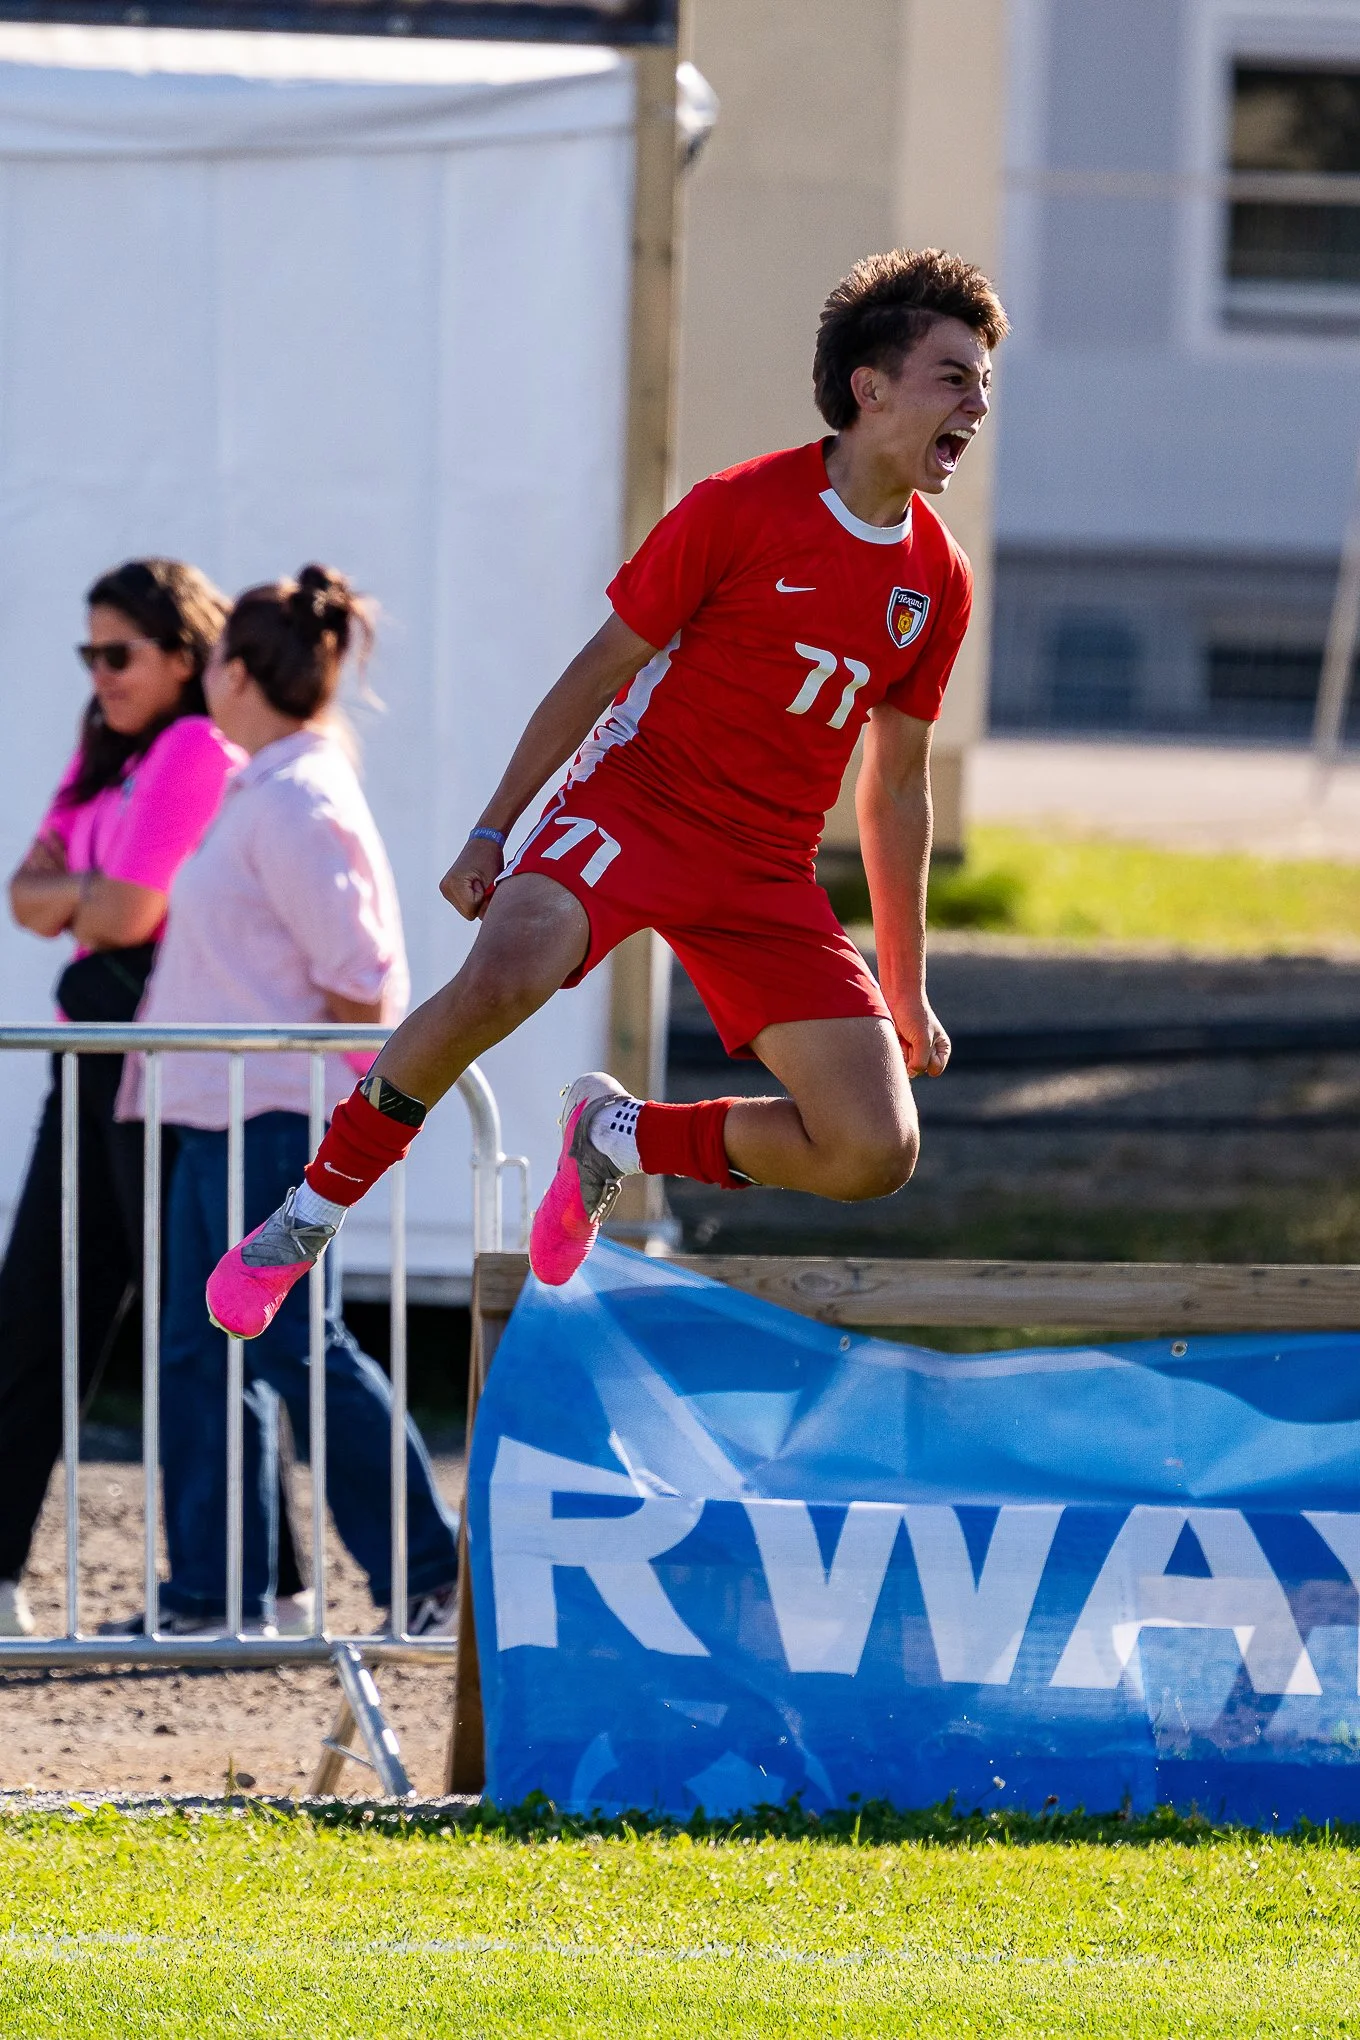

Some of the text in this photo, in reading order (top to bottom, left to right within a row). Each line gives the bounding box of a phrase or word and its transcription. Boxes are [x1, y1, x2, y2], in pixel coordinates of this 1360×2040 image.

[897, 593, 923, 609] Texans
[785, 641, 871, 730] 77
[540, 816, 622, 888] 77
